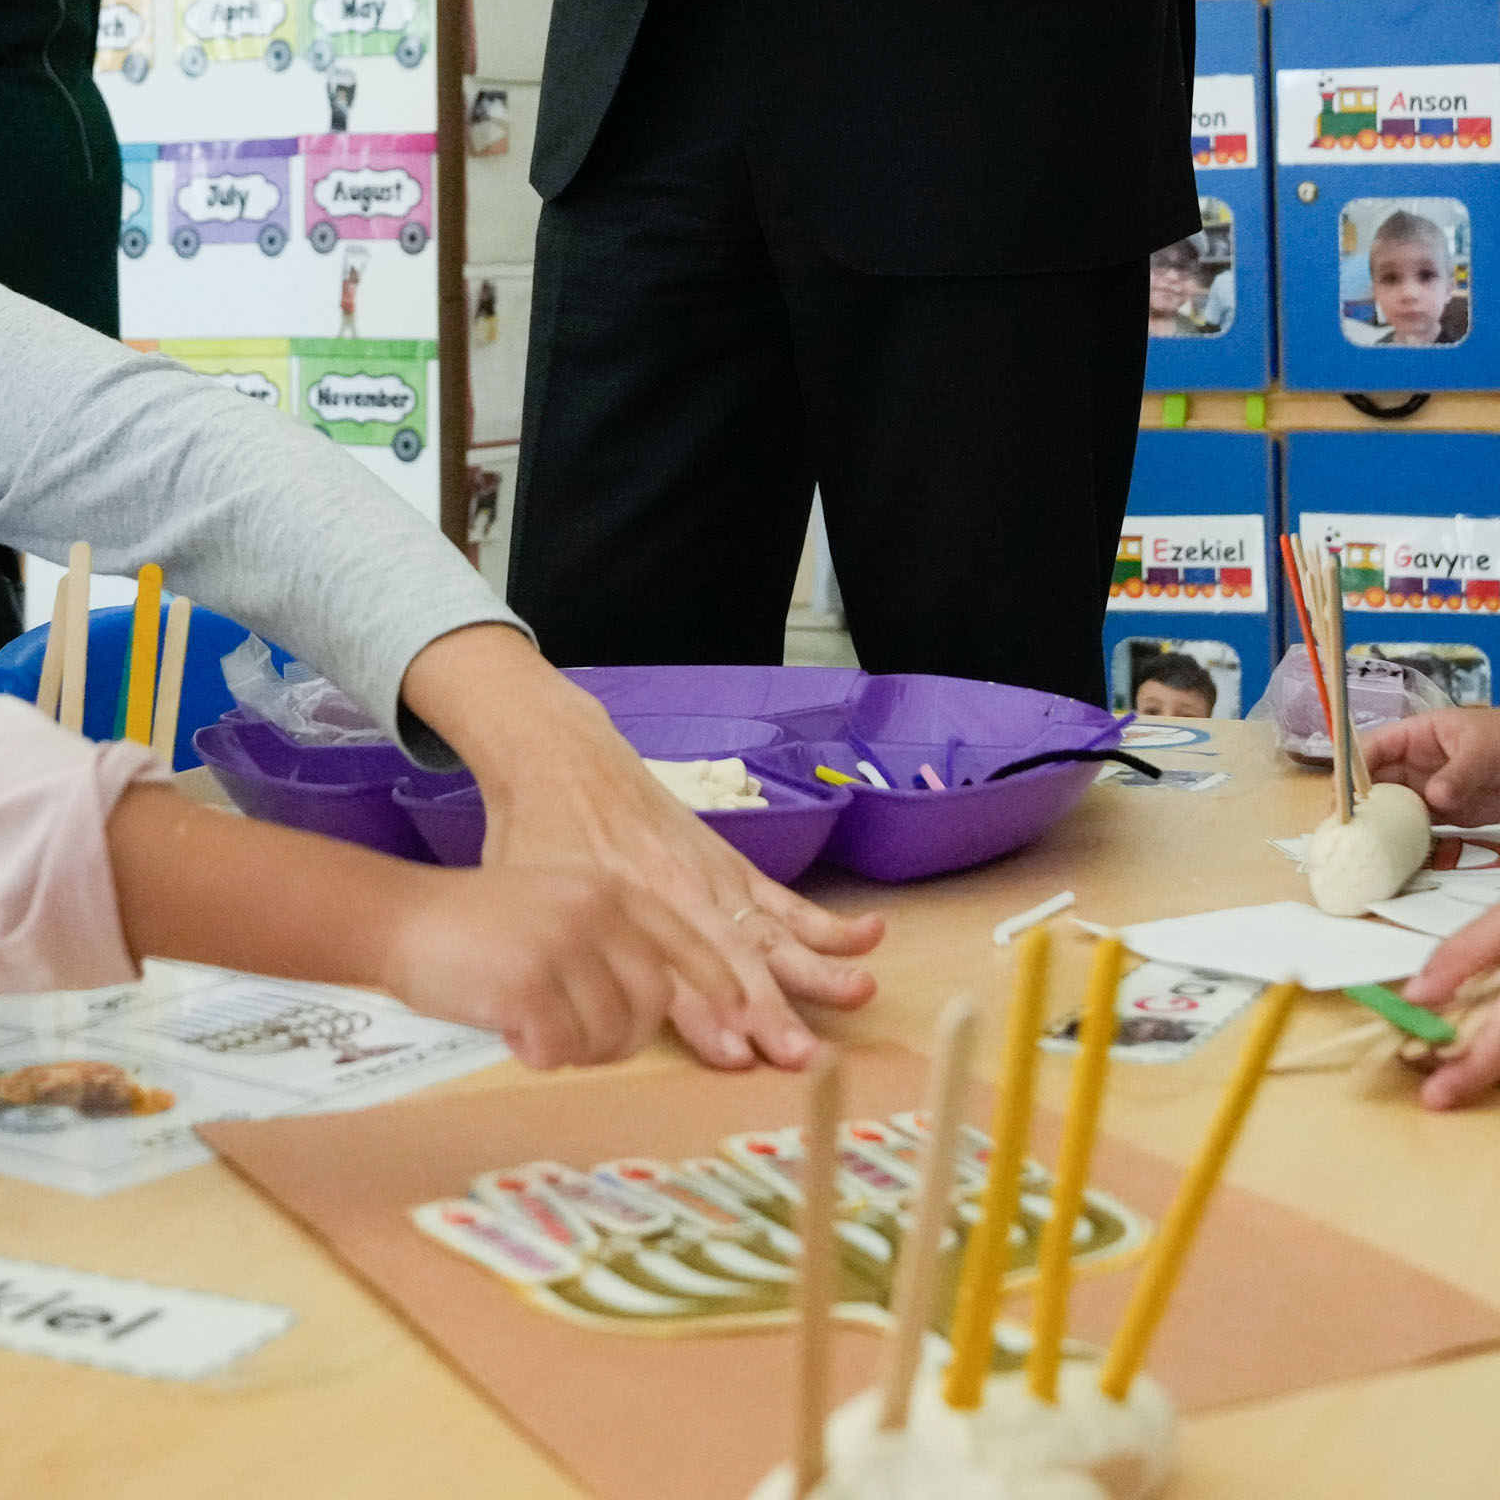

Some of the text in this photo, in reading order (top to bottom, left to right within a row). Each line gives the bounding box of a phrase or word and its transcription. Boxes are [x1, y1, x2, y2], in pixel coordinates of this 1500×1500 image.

[210, 2, 260, 31] April
[1388, 91, 1468, 113] Anson
[207, 184, 249, 218] July
[332, 180, 403, 213] August
[317, 385, 409, 408] November
[1152, 538, 1245, 563] Ezekiel
[1393, 544, 1491, 579] Gavyne
